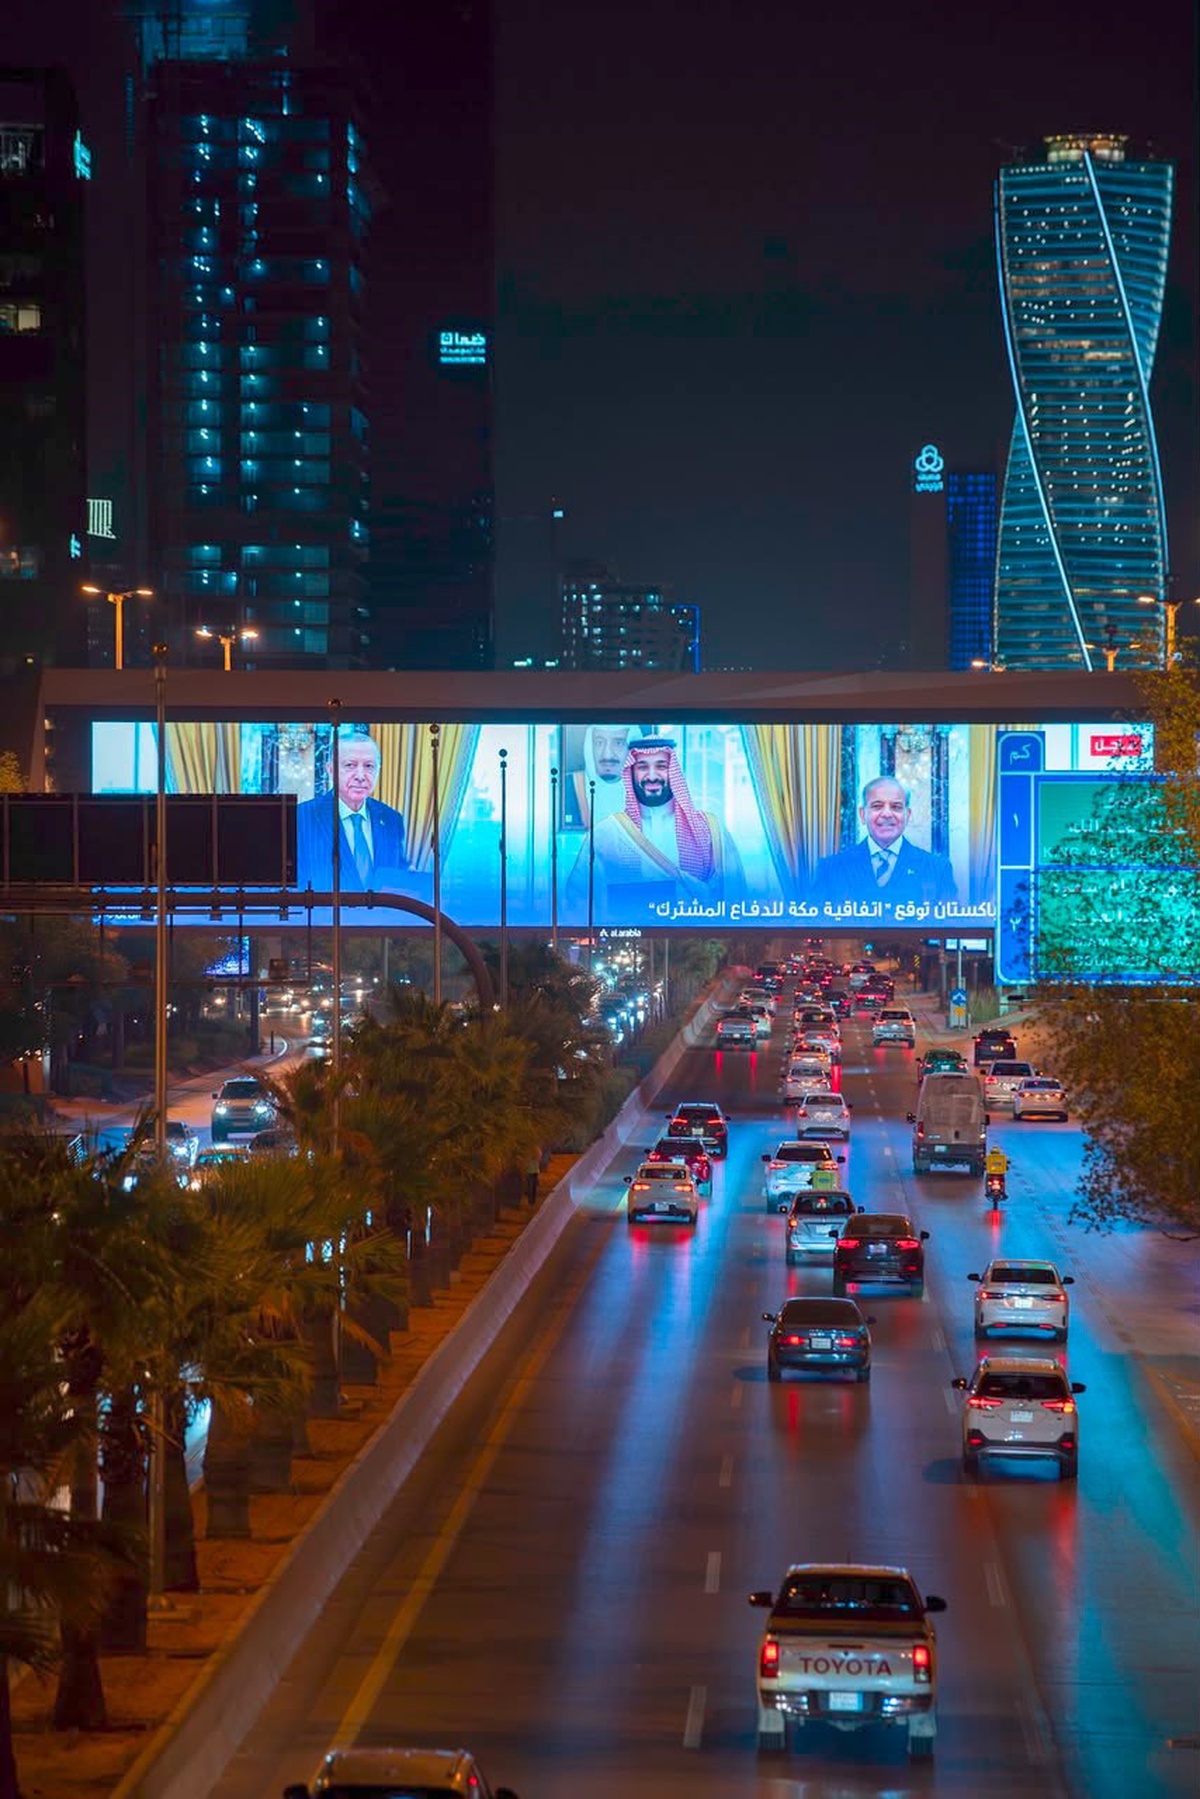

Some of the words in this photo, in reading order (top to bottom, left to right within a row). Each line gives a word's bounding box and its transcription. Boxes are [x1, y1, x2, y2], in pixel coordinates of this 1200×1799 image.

[1009, 743, 1032, 765] كم
[730, 900, 784, 920] للدفاع
[788, 900, 819, 917] مكة
[894, 901, 930, 921] توقع
[799, 1657, 892, 1676] TOYOTA
